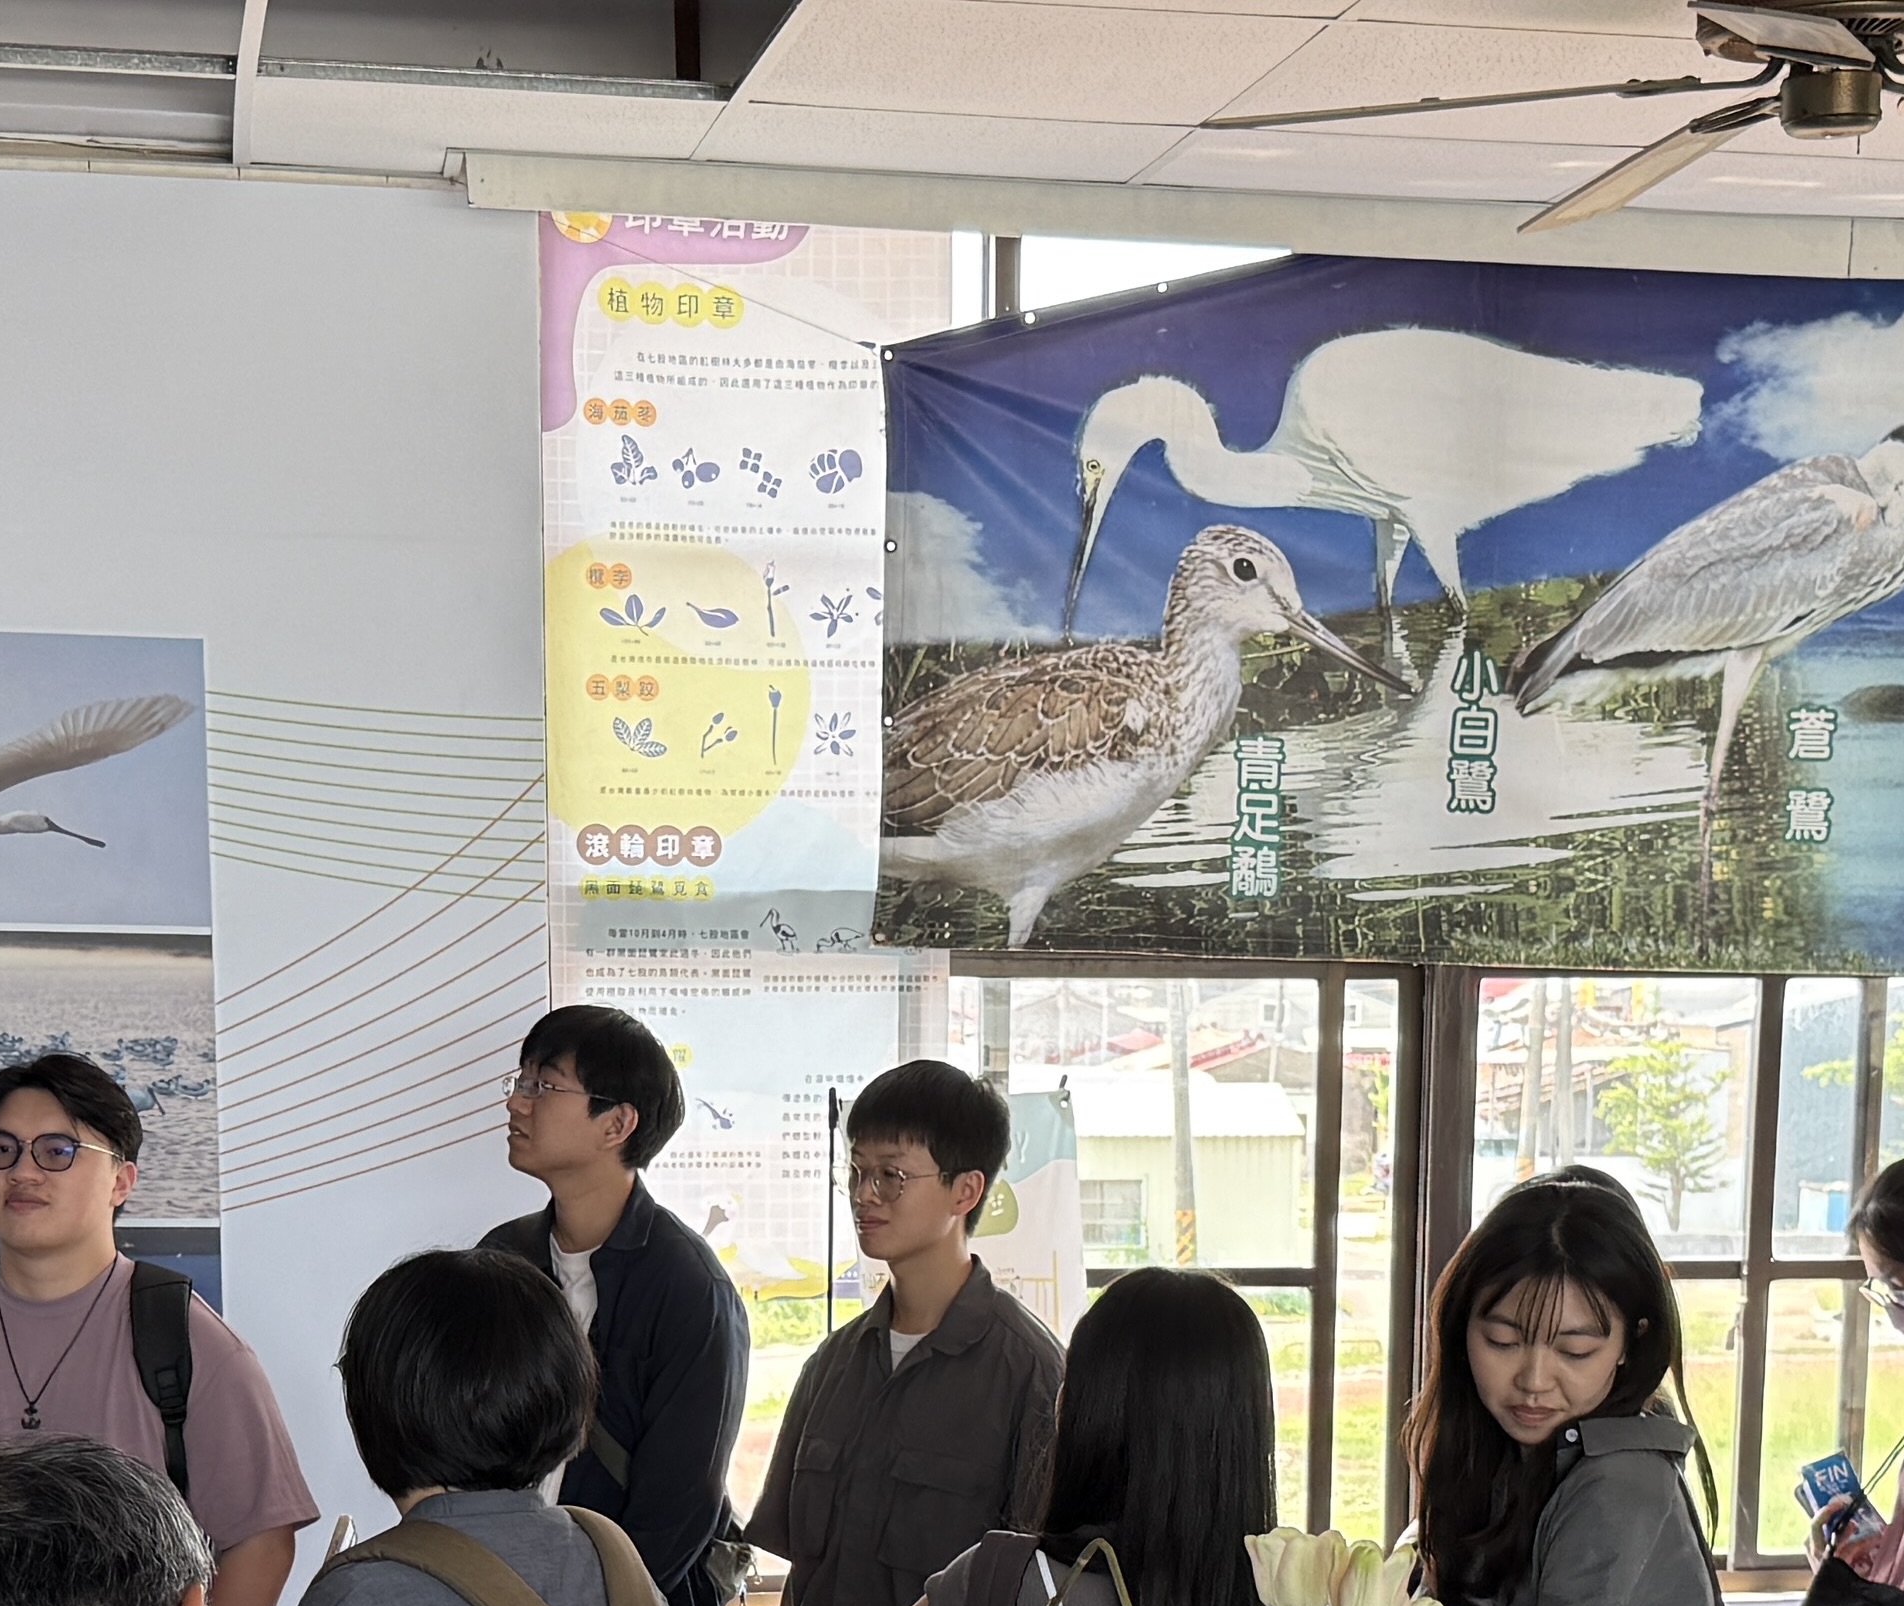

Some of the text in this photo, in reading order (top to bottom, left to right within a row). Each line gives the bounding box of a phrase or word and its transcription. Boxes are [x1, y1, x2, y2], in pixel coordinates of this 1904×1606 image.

[607, 287, 736, 320] 植物印章
[1447, 650, 1500, 814] 小白鷺
[1785, 707, 1839, 843] 蒼鷺
[585, 833, 715, 860] 滾輪印章
[1231, 736, 1285, 899] 青足鷸
